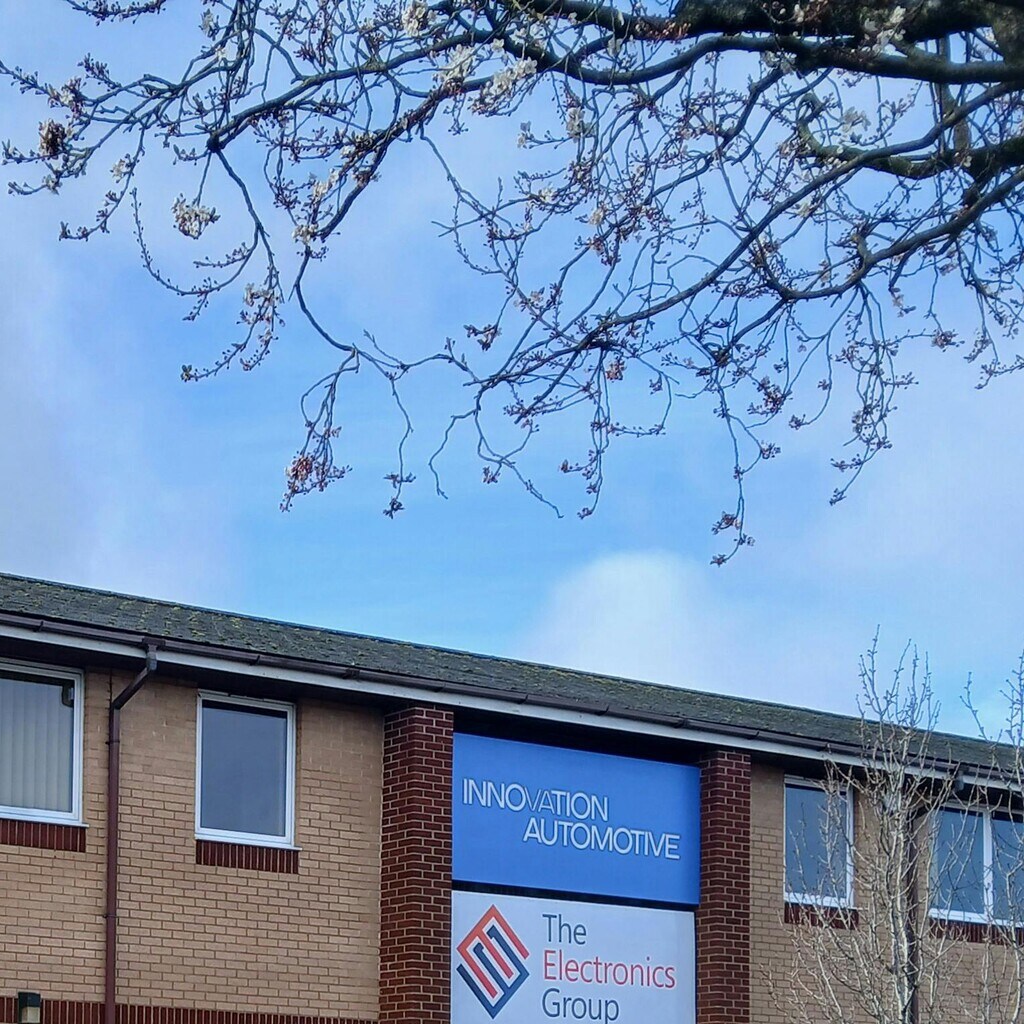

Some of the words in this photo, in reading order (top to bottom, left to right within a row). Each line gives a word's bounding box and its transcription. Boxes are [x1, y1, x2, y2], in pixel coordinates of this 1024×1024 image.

[462, 778, 609, 822] INNOVATION
[523, 816, 681, 860] AUTOMOTIVE
[542, 913, 587, 945] The
[543, 949, 676, 989] Electronics
